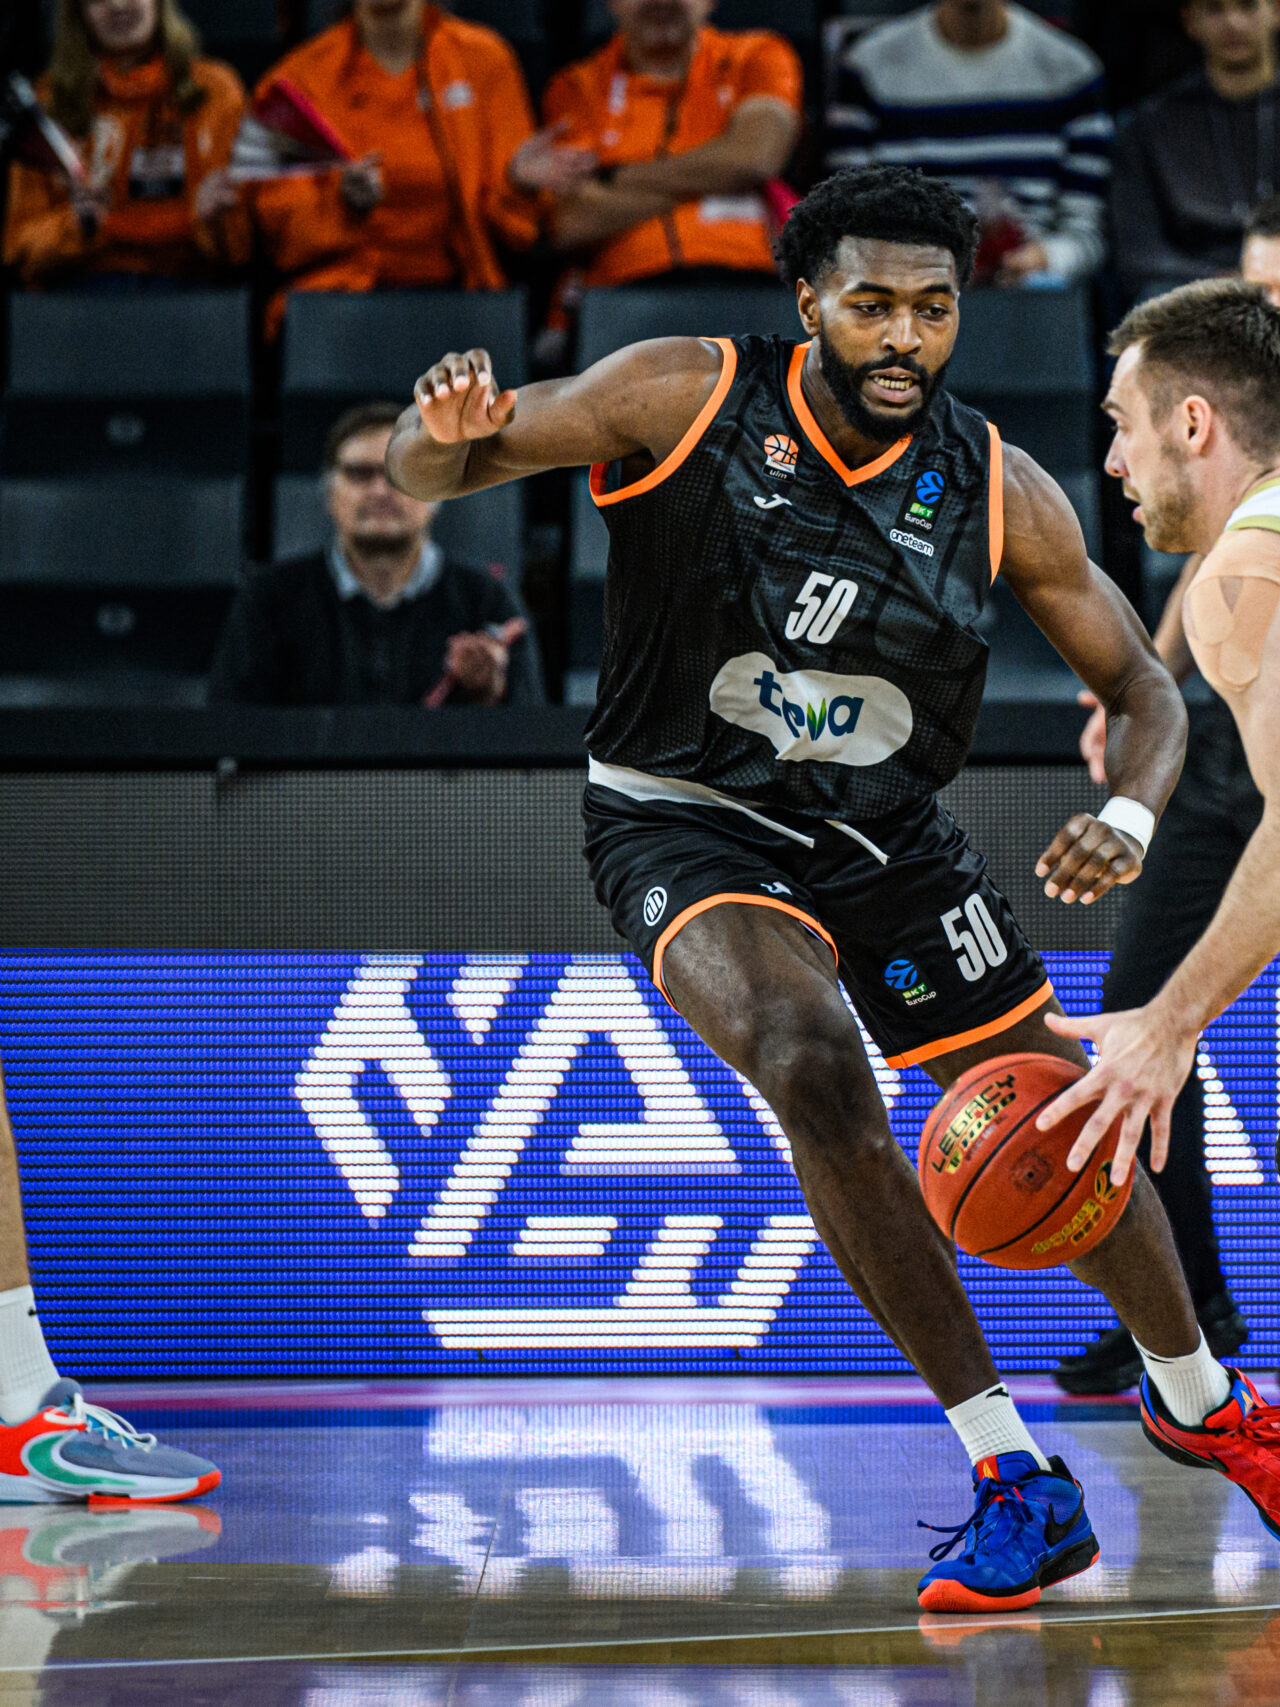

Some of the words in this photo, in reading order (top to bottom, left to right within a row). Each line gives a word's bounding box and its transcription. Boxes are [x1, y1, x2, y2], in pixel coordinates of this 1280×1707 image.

[769, 469, 788, 480] ulm
[904, 513, 933, 530] EuroCup
[784, 570, 859, 645] 50
[753, 670, 865, 742] teva
[940, 892, 1008, 982] 50
[905, 990, 937, 1006] EuroCup
[931, 1074, 1016, 1174] LEGACY
